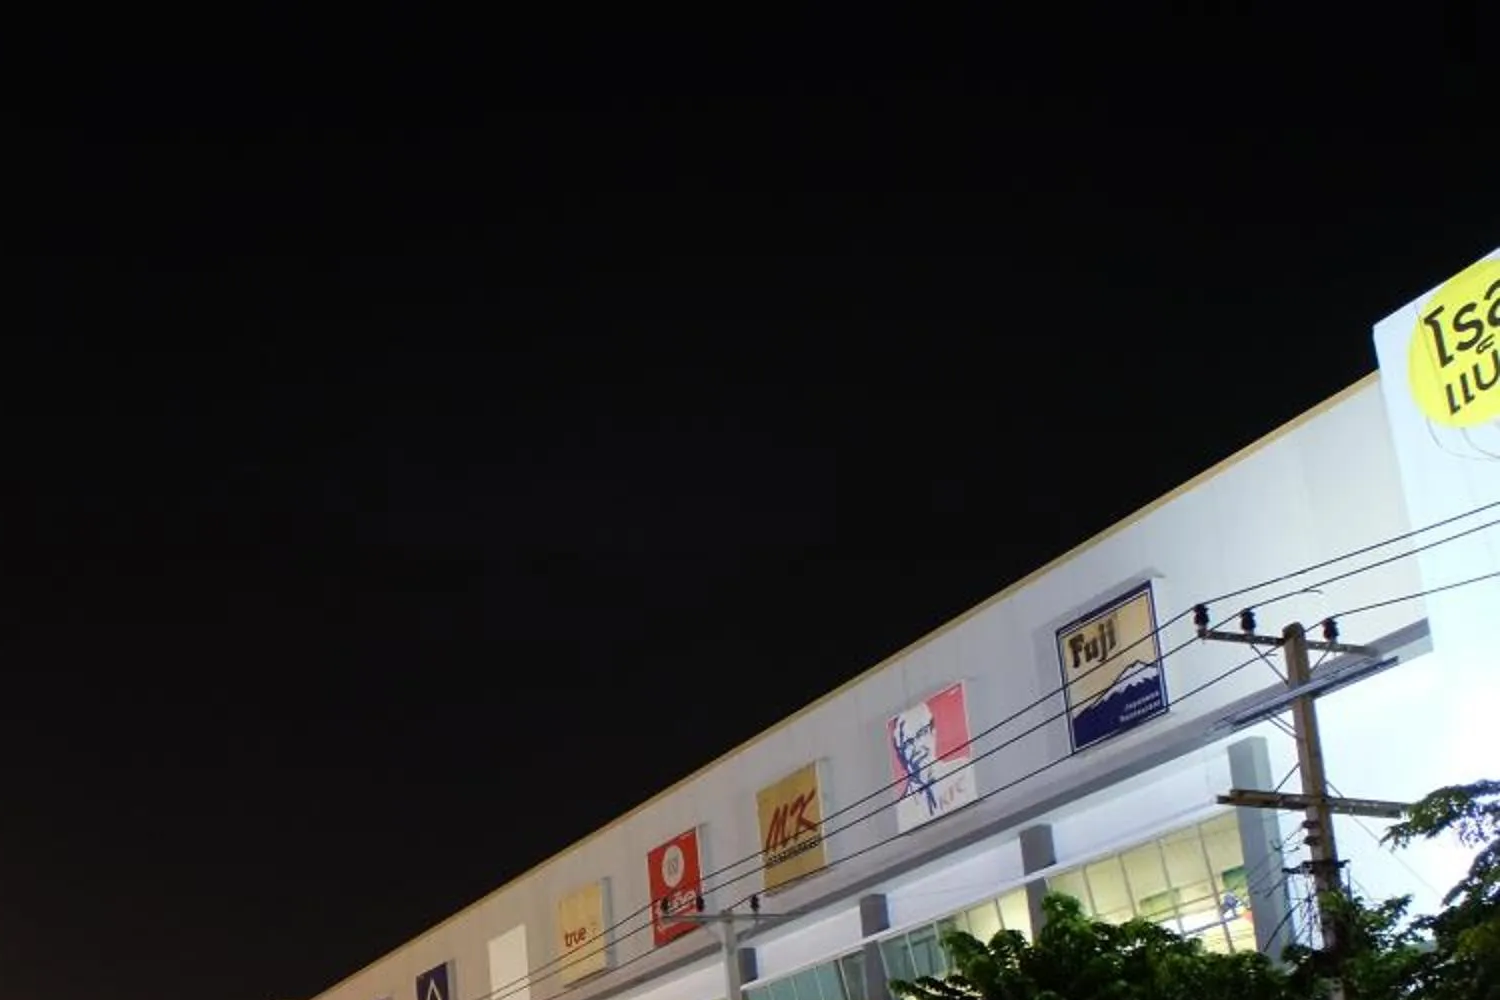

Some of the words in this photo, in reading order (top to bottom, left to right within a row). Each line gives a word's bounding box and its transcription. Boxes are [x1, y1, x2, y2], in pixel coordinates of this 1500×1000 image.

[1069, 613, 1118, 669] Fuji
[765, 788, 818, 853] MK
[563, 927, 588, 948] true
